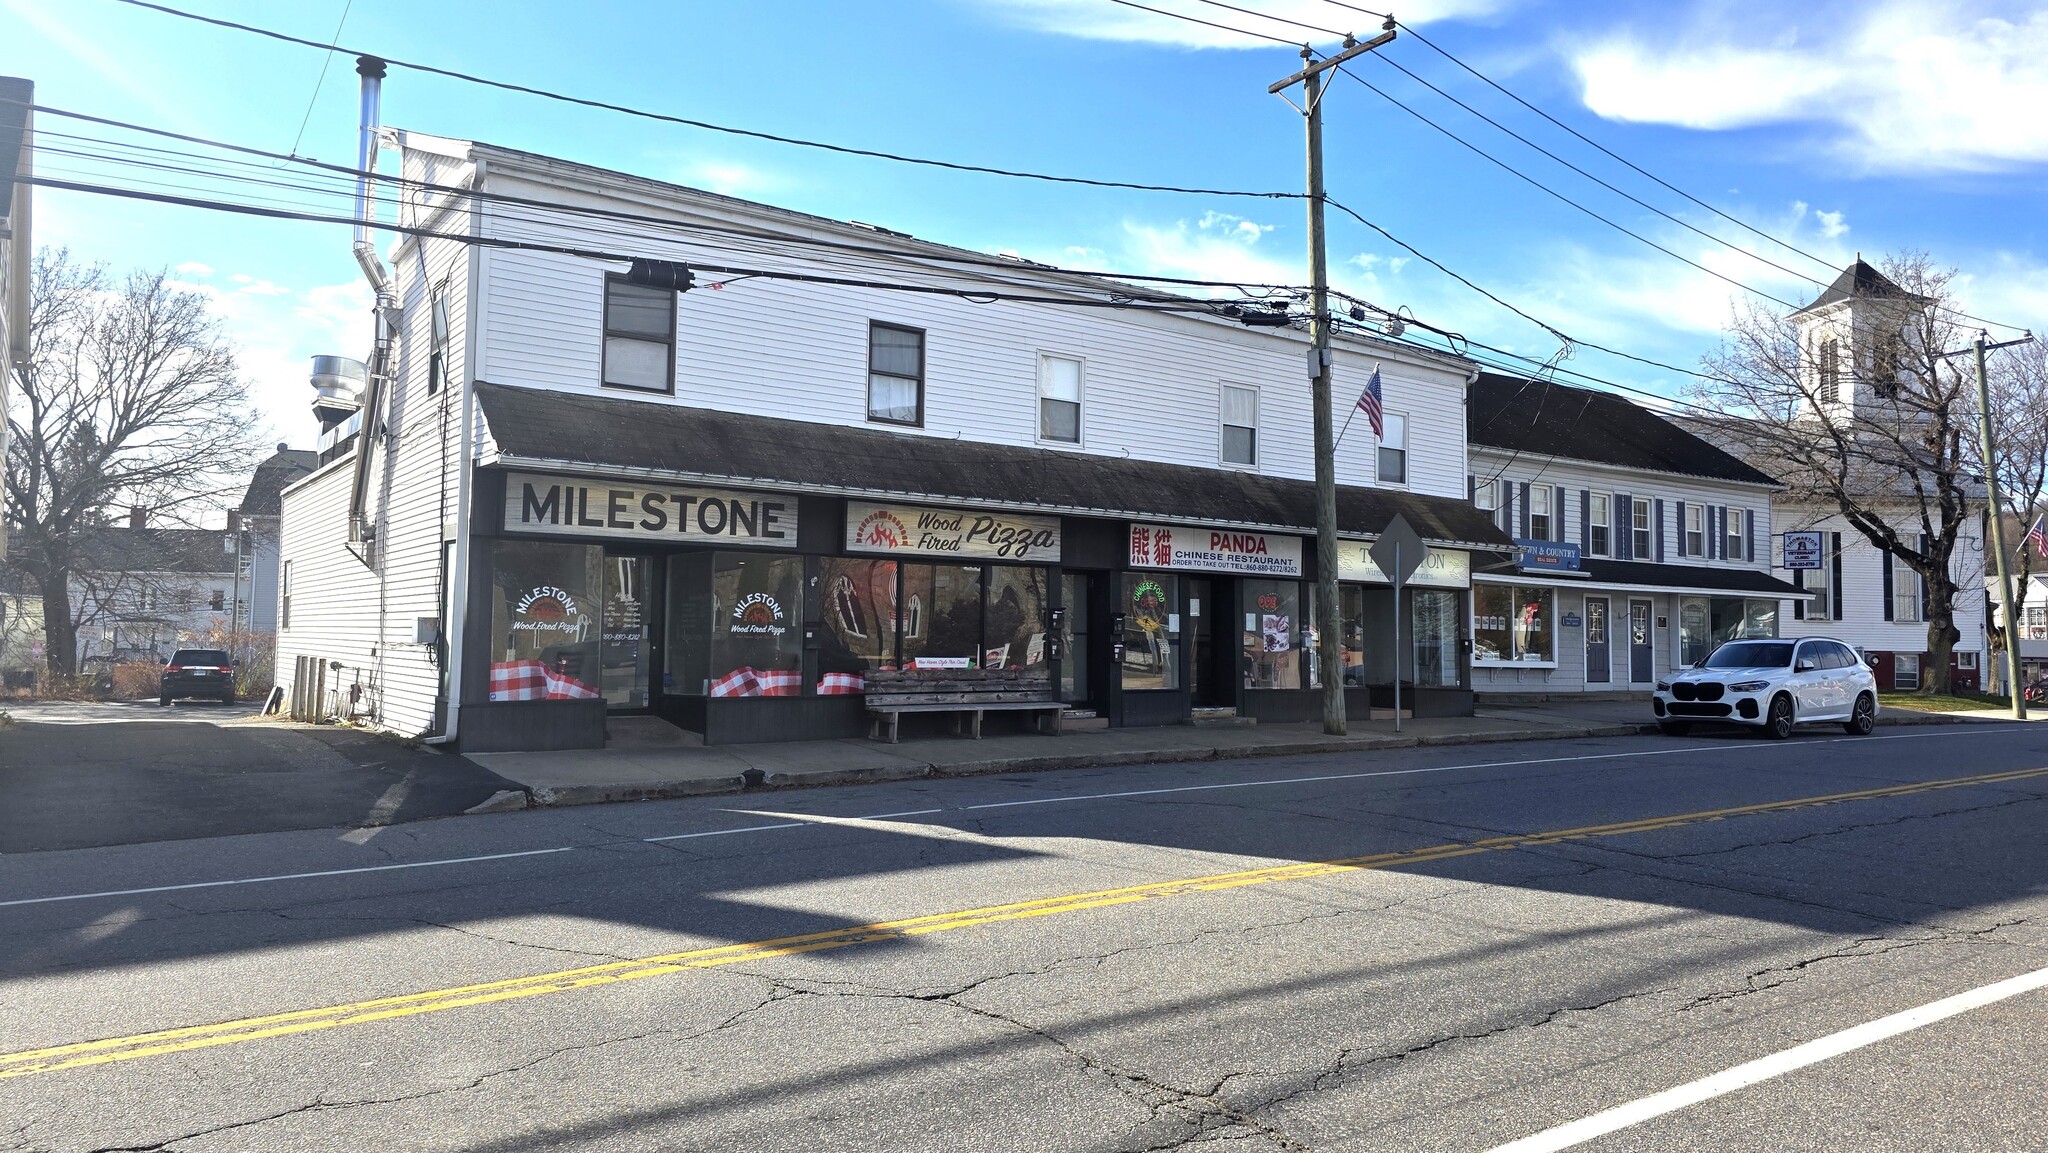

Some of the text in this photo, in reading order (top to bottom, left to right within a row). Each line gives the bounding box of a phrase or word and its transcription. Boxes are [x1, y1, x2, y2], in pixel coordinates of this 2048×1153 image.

[522, 483, 785, 538] MILESTONE
[917, 512, 964, 531] Wood
[917, 532, 963, 551] Fired
[966, 516, 1055, 557] Pizza
[1210, 532, 1268, 555] PANDA
[1786, 536, 1818, 548] THOMASTON
[1175, 550, 1293, 566] CHINESE RESTAURANT
[1539, 546, 1545, 555] &
[1546, 547, 1576, 558] COUNTRY
[1172, 559, 1192, 567] ORDER
[516, 586, 577, 616] MILESTONE
[1133, 582, 1165, 602] CHINESE FOOD
[733, 592, 784, 620] MILESTONE
[513, 621, 580, 634] Wood Fired Pizza
[731, 624, 786, 636] Wood Fired Pizza
